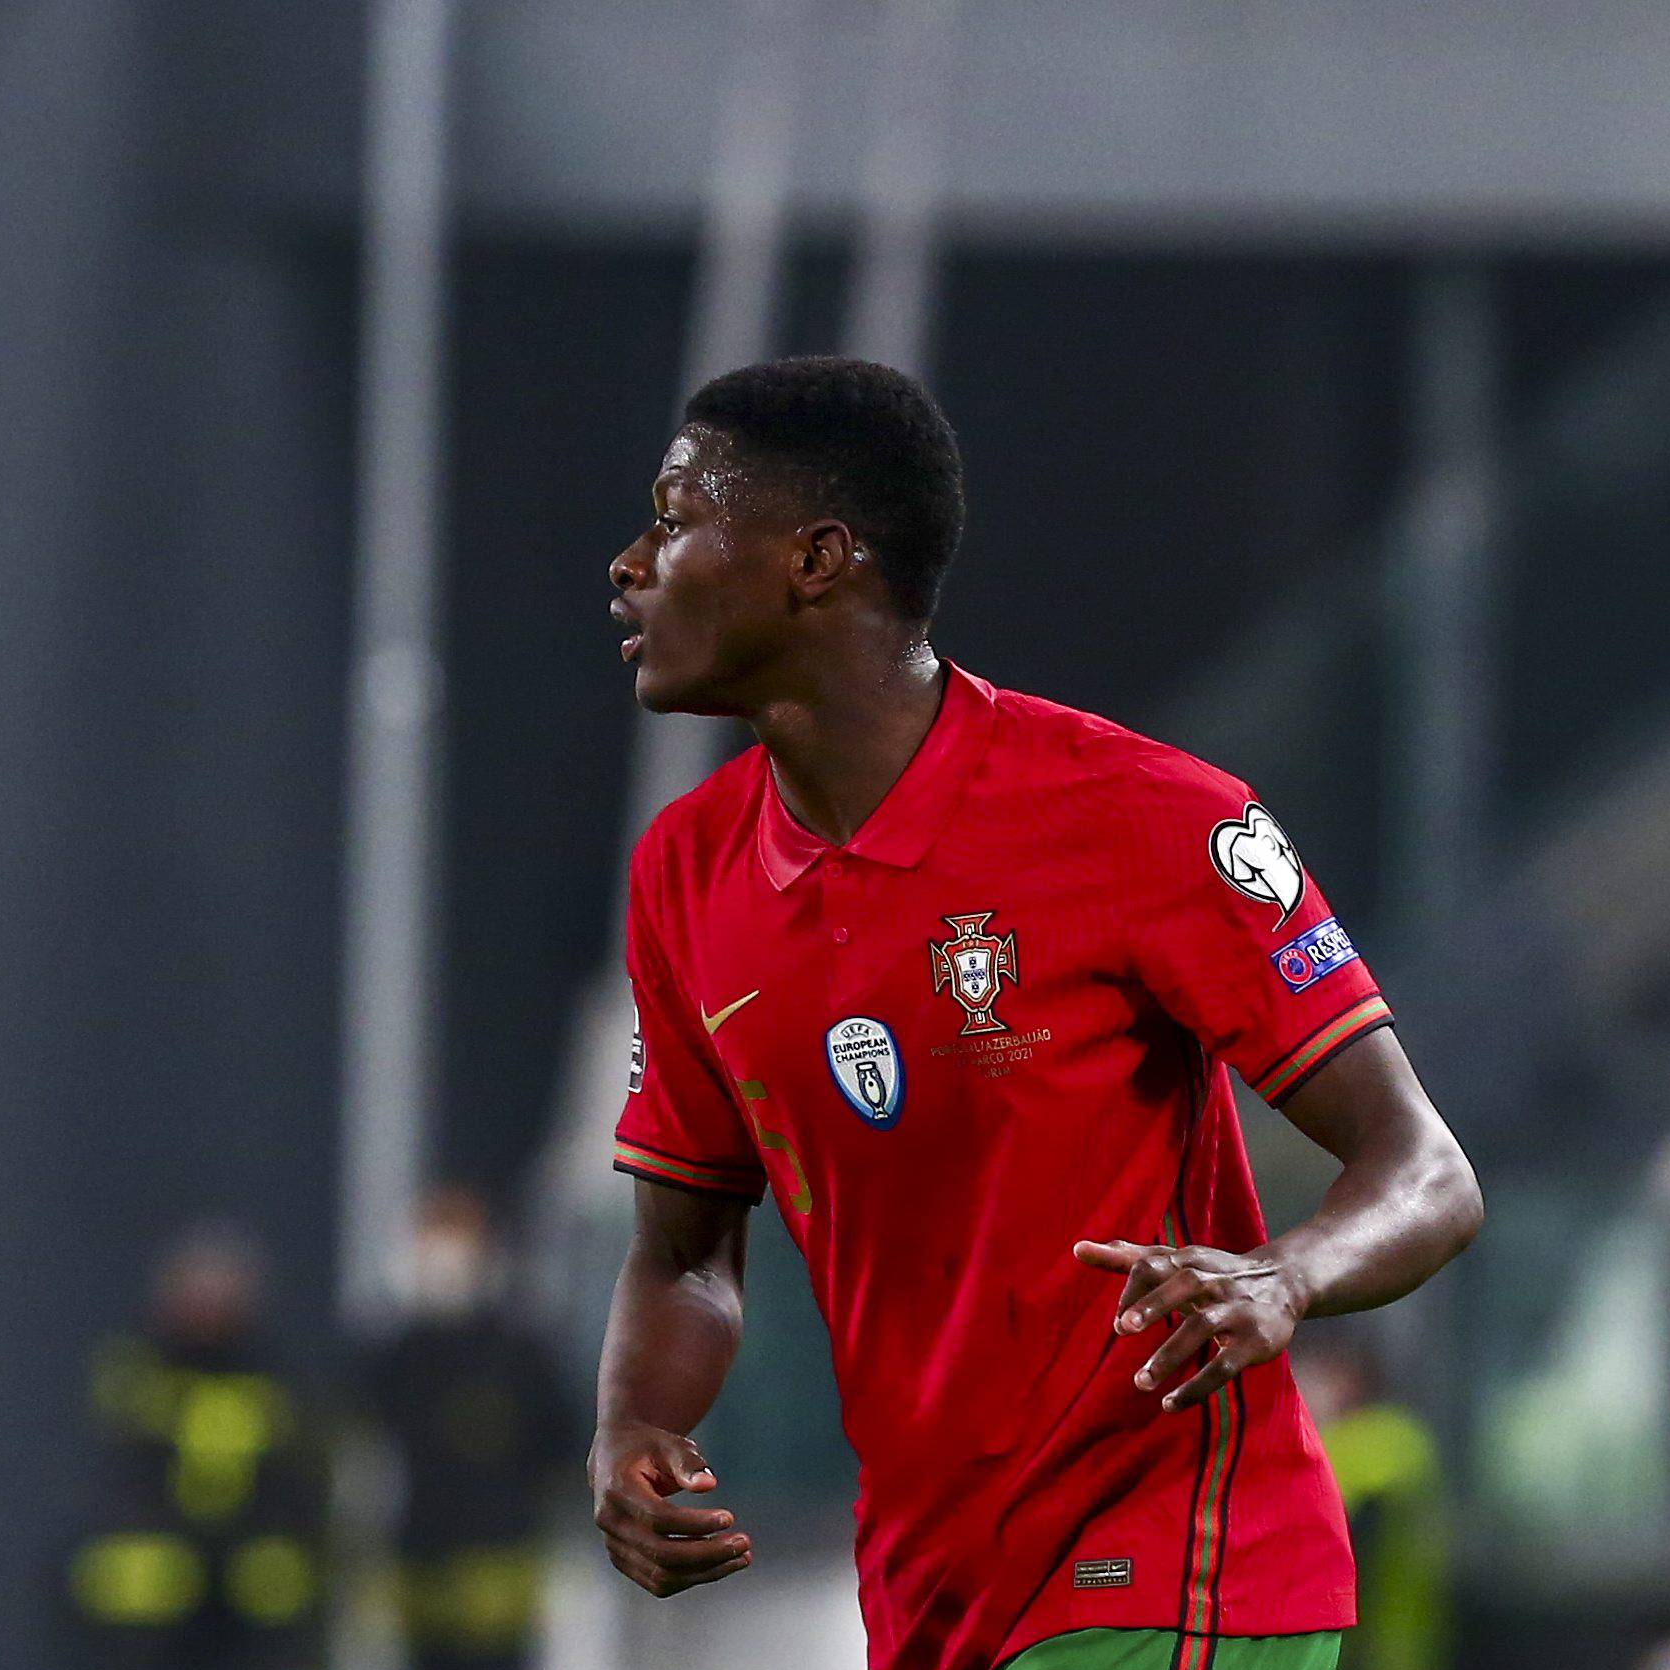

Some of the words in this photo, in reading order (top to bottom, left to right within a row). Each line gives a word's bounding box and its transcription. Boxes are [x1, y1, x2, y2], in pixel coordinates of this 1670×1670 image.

[842, 1024, 870, 1038] UEFA
[832, 1037, 888, 1054] EUROPEAN
[835, 1047, 890, 1064] CHAMPIONS
[1008, 1047, 1033, 1062] 2021
[734, 1078, 813, 1216] 5
